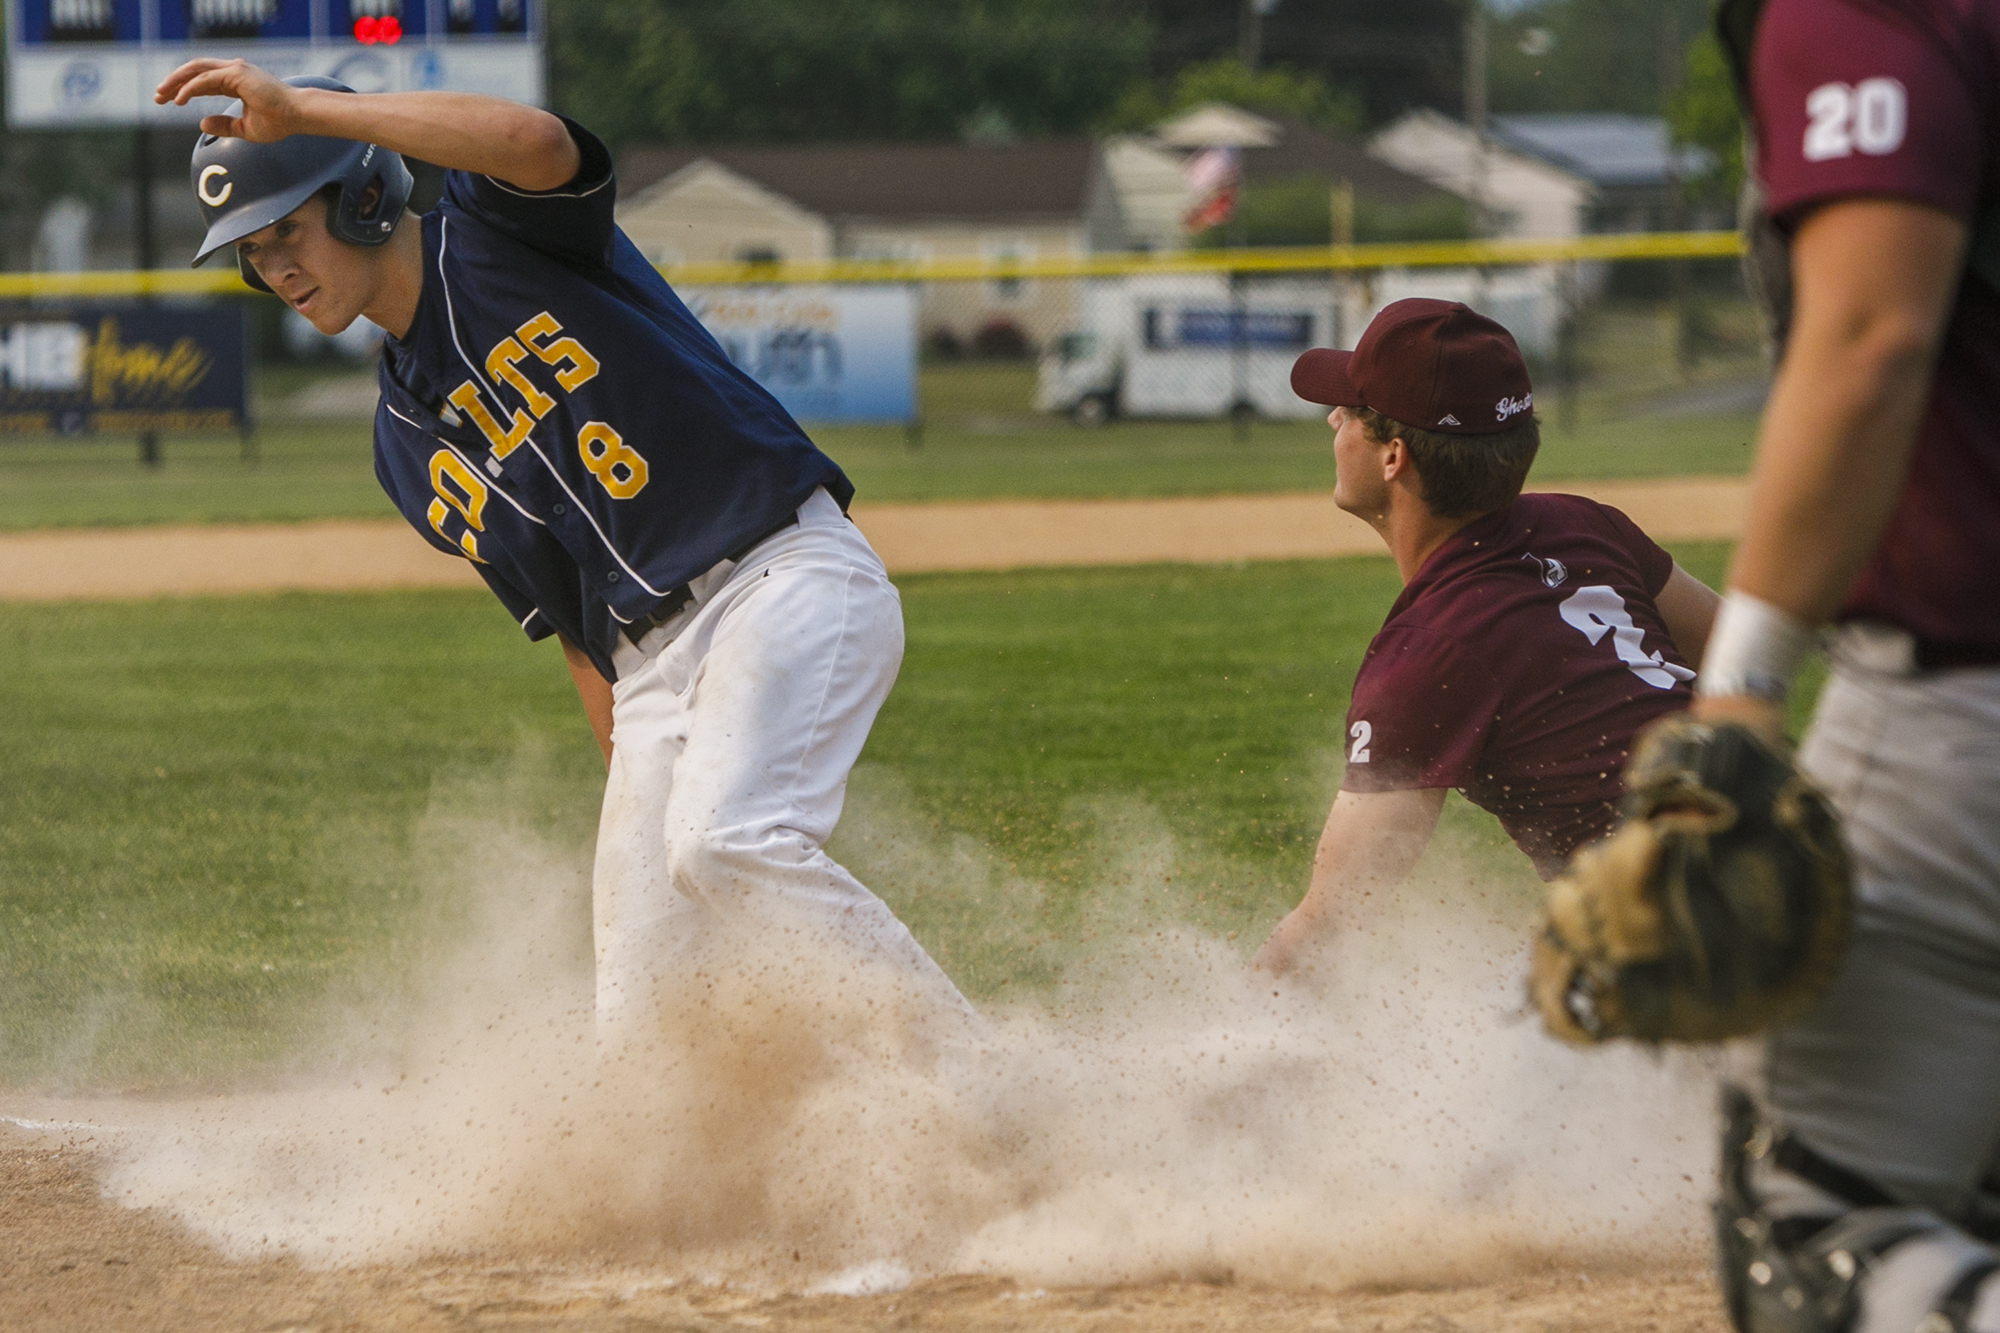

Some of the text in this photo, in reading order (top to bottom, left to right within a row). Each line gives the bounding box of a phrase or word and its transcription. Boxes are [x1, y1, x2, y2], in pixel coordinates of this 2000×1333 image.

[1803, 77, 1907, 161] 20
[198, 164, 233, 207] C
[577, 420, 649, 500] 8
[1349, 719, 1372, 763] 2
